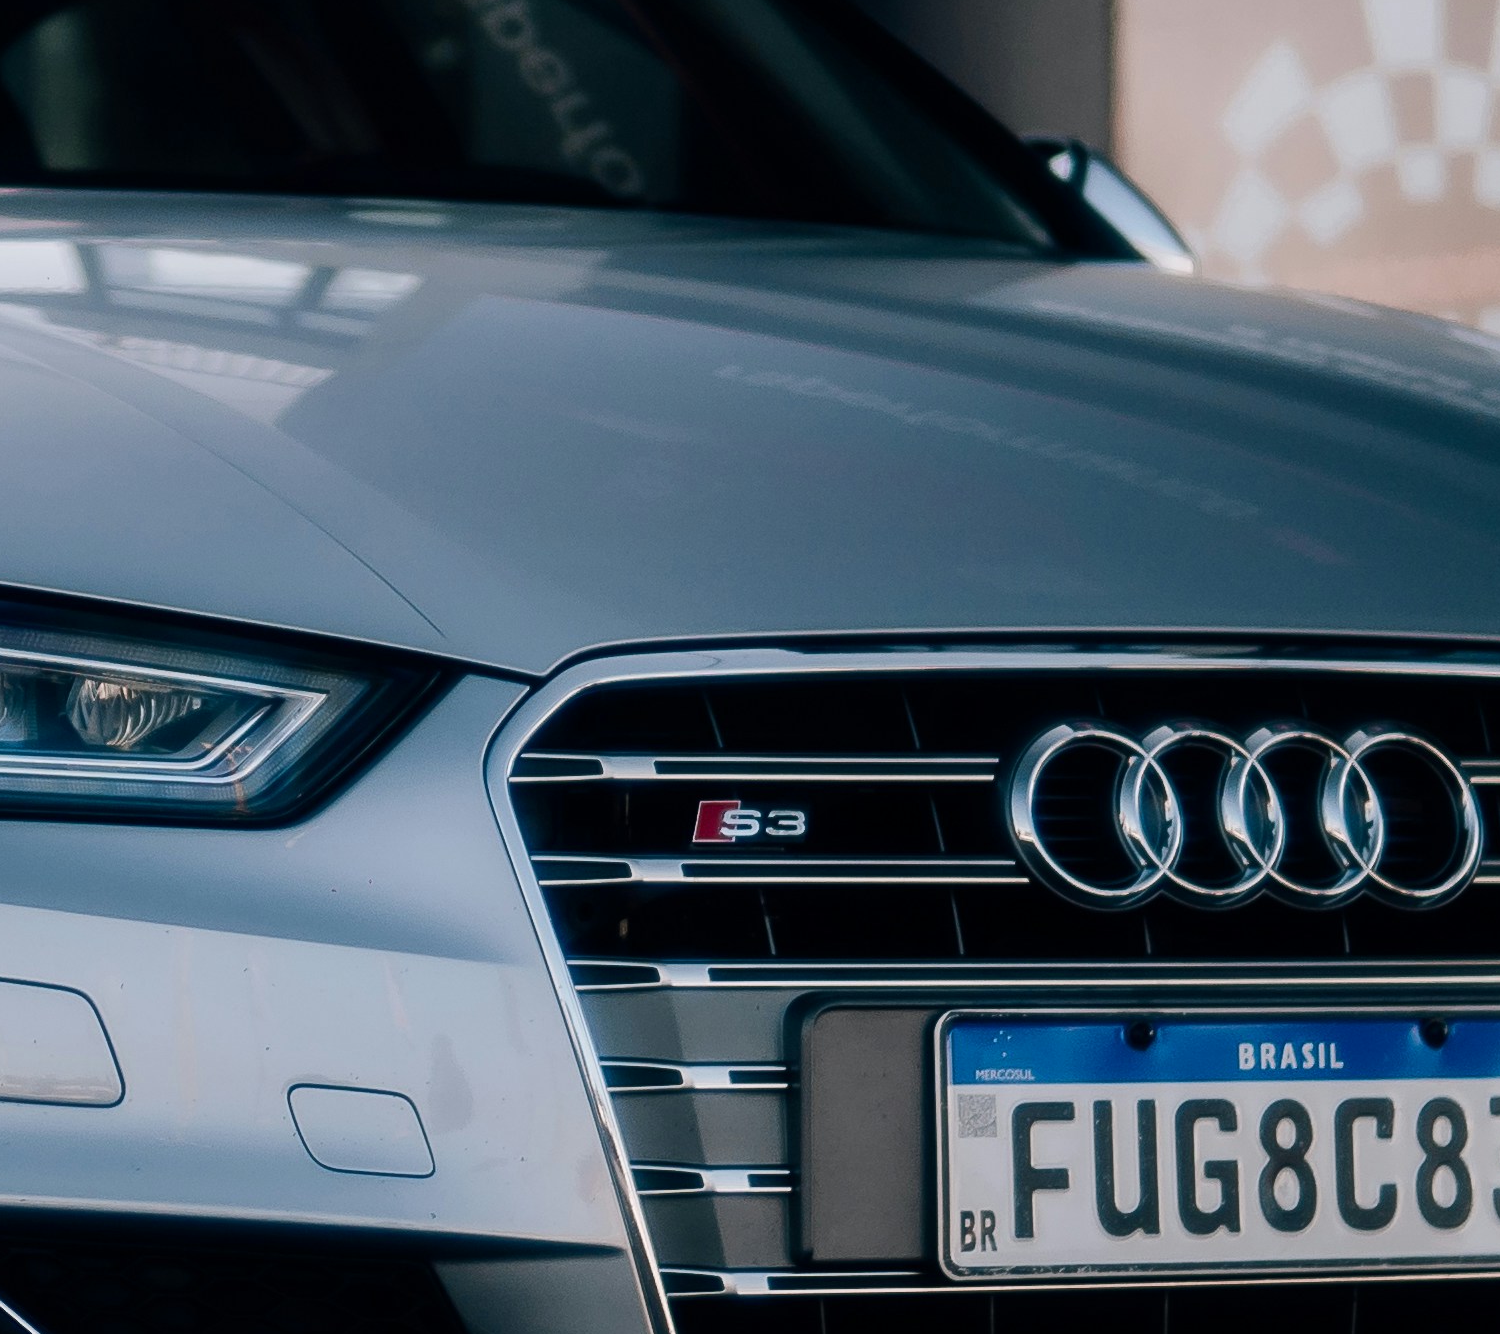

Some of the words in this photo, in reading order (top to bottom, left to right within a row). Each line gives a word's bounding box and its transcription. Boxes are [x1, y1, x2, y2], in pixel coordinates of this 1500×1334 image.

[720, 809, 806, 837] S3
[1238, 1042, 1345, 1071] BRASIL
[975, 1068, 1036, 1080] MERCOSUL
[960, 1209, 998, 1253] BR
